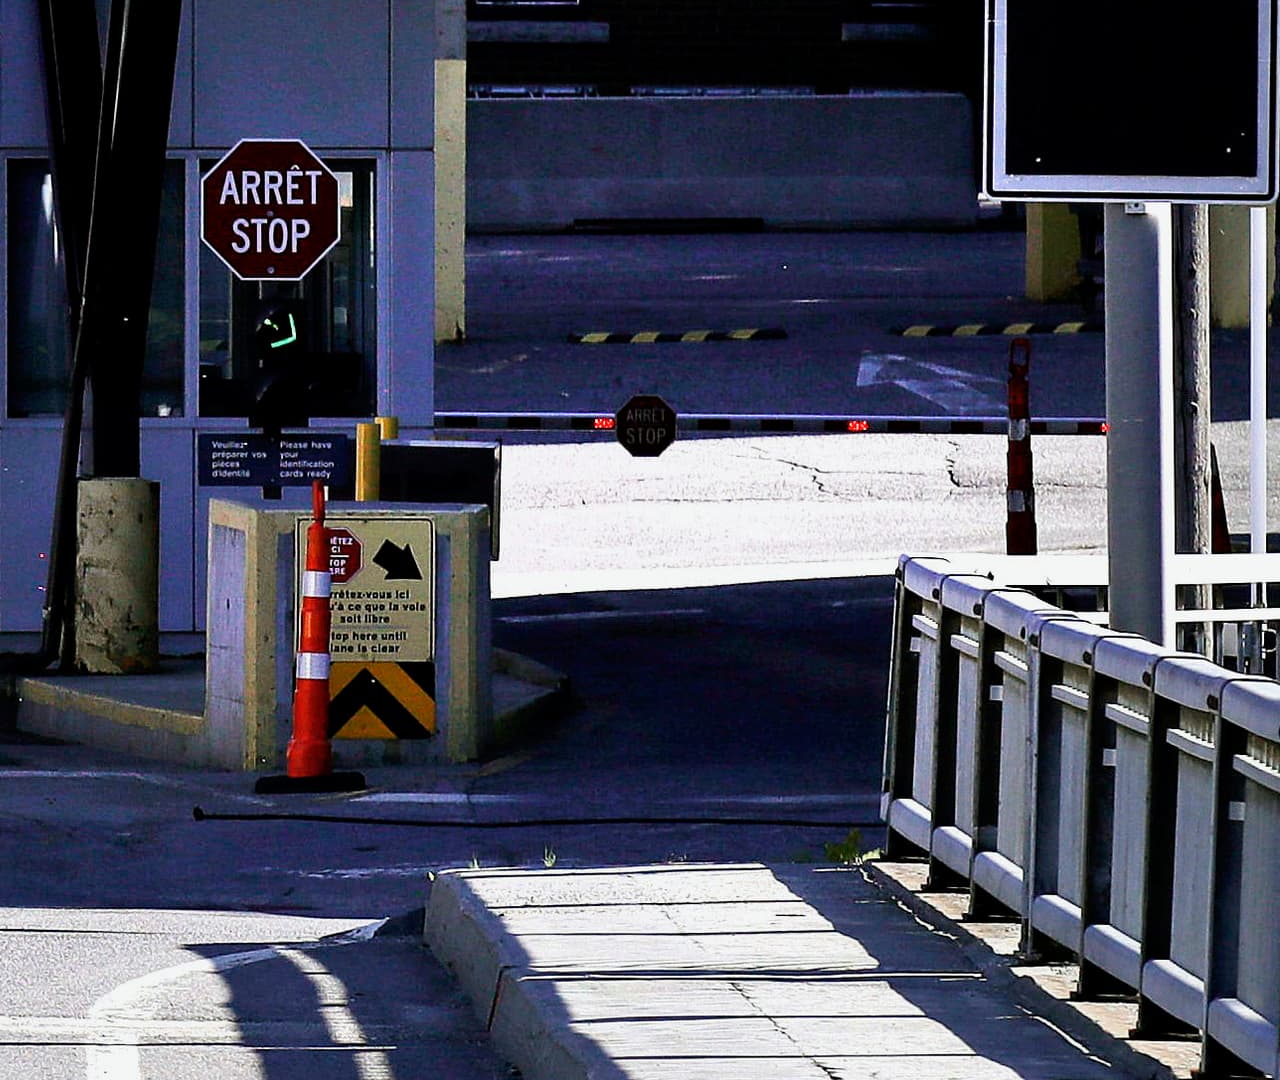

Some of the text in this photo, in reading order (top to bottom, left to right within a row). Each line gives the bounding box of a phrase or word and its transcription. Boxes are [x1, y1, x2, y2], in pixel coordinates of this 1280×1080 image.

[218, 164, 323, 205] ARRÊT
[231, 217, 311, 254] STOP
[626, 427, 667, 445] STOP
[280, 440, 333, 449] Please have
[280, 451, 299, 460] your
[280, 460, 335, 469] identification
[279, 469, 332, 480] cards ready
[347, 603, 361, 611] ce
[365, 603, 385, 613] que
[389, 601, 399, 611] la
[402, 601, 426, 611] voie
[340, 613, 390, 623] soit libre
[331, 631, 407, 642] top here until
[330, 643, 400, 653] lane is clear
